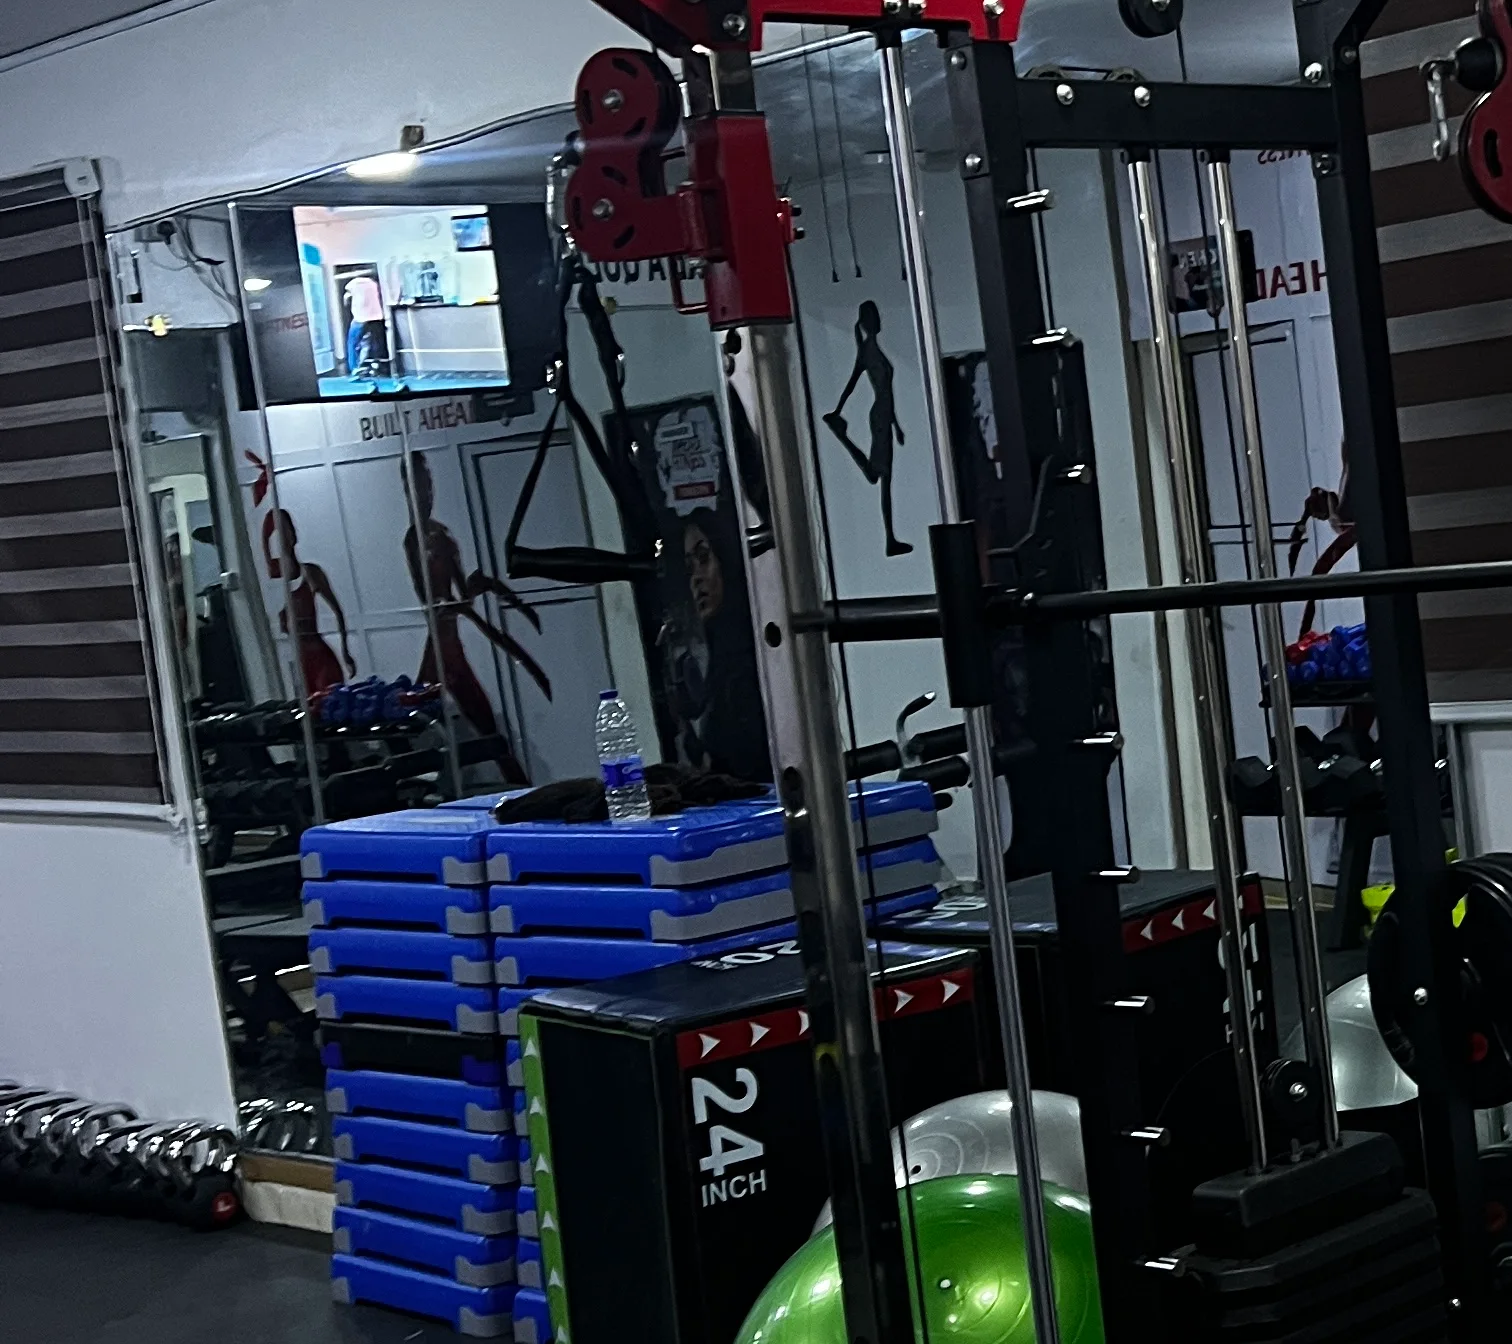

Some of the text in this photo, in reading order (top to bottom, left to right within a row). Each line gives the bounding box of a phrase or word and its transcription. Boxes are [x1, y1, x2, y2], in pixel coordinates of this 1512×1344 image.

[420, 402, 470, 430] AHEA
[691, 1067, 766, 1178] 24
[701, 1169, 768, 1208] INCH
